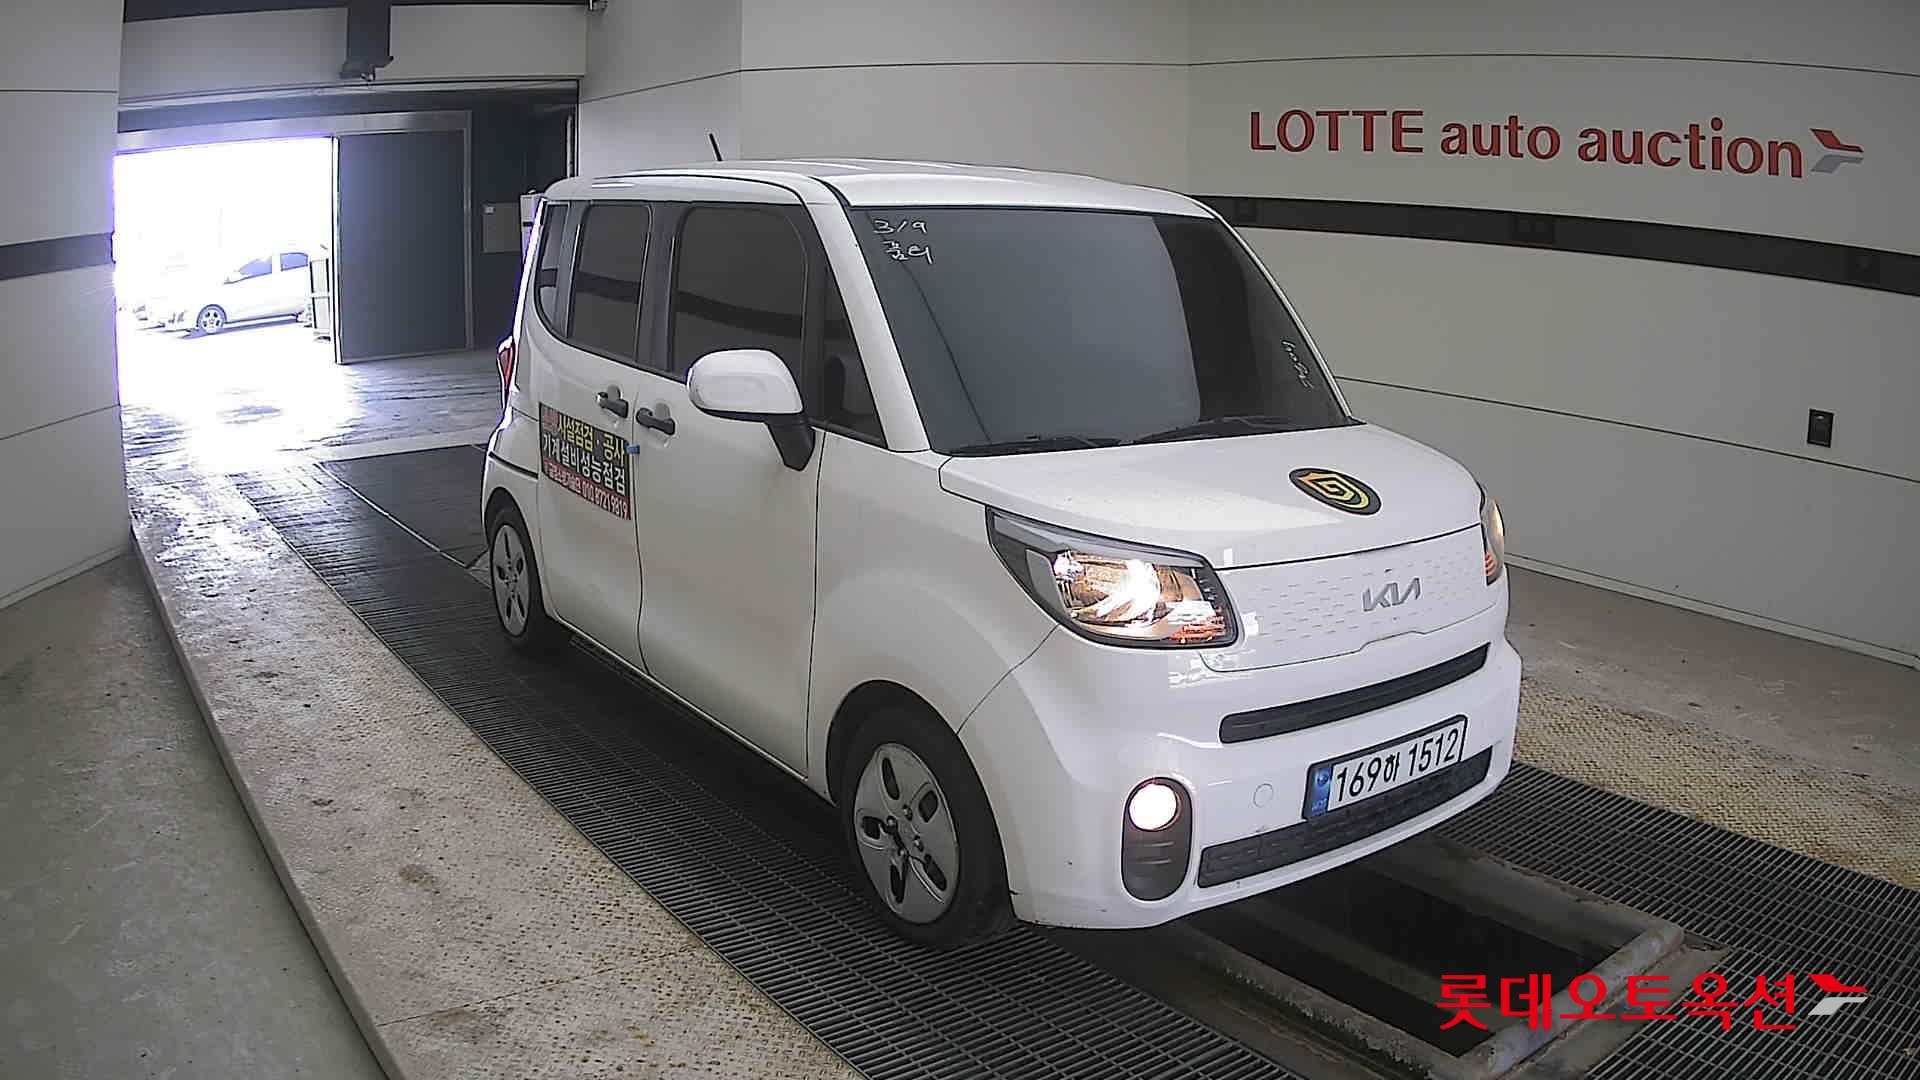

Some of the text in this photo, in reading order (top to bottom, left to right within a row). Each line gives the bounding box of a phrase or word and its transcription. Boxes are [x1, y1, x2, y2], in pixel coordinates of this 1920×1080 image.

[1250, 109, 1803, 178] LOTTE auto auction
[603, 432, 624, 467] 공사
[1362, 577, 1421, 612] KIA
[1336, 728, 1459, 802] 169하 1512
